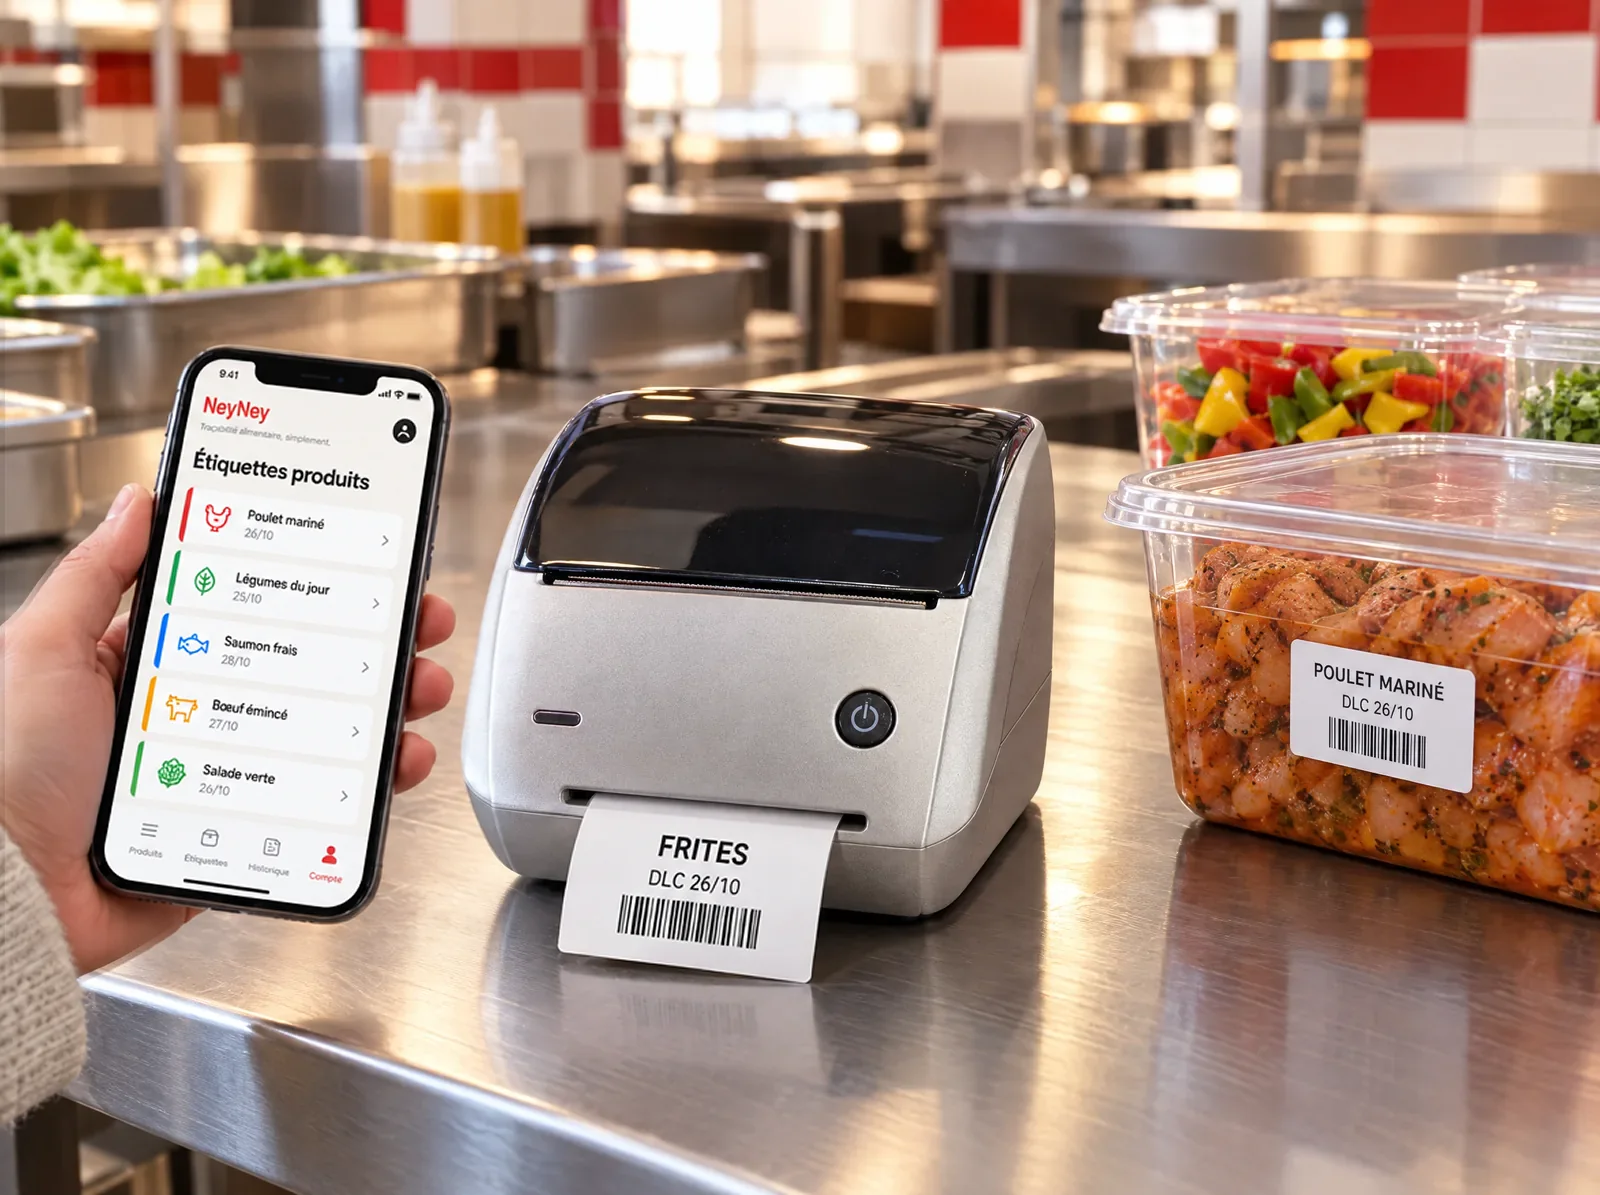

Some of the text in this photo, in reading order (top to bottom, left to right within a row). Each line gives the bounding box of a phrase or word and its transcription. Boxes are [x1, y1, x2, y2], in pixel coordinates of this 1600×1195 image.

[203, 396, 270, 424] NeyNey
[193, 447, 369, 490] Étiquettes produits
[247, 510, 325, 530] Poulet mariné
[244, 528, 274, 541] 26/10
[235, 572, 331, 596] Légumes du jour
[232, 591, 263, 605] 25/10
[224, 636, 298, 657] Saumon frais
[220, 655, 251, 668] 28/10
[1315, 663, 1445, 701] POULET MARINÉ
[247, 704, 288, 720] émincé
[1343, 694, 1413, 721] DLC 26/10
[208, 718, 239, 732] 27/10
[202, 764, 276, 785] Salade verte
[198, 783, 231, 797] 26/10
[128, 846, 163, 859] Produits
[658, 835, 749, 865] FRITES
[308, 871, 343, 884] Compte
[649, 870, 740, 895] DLC 26/10
